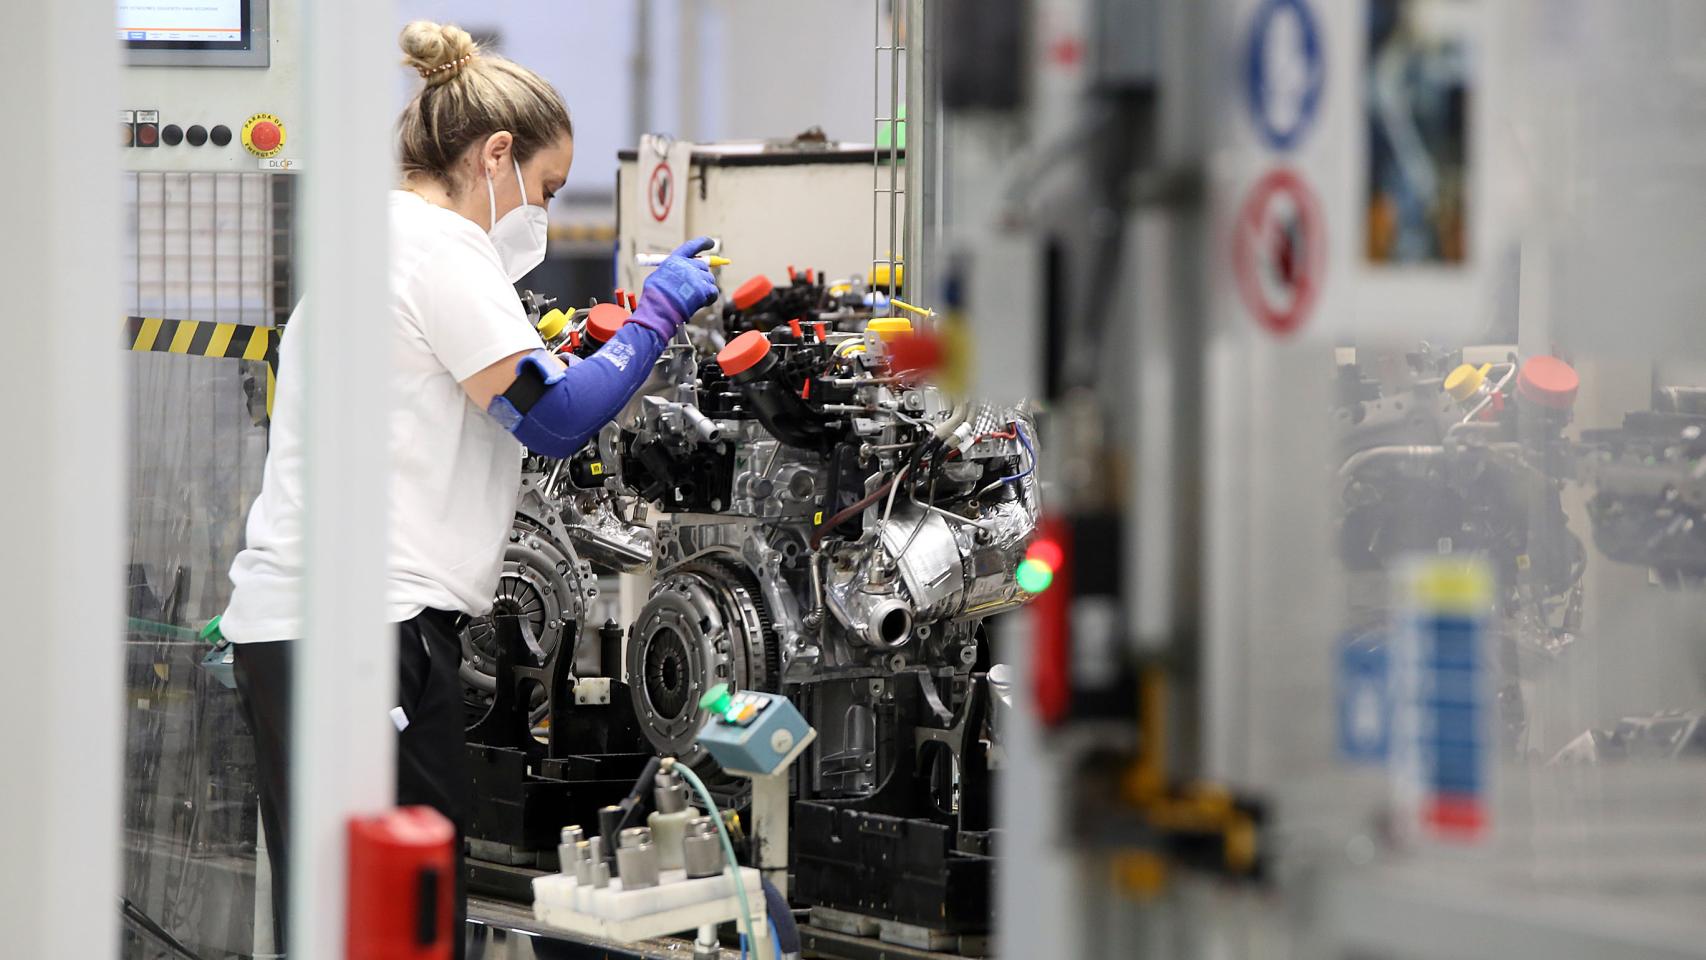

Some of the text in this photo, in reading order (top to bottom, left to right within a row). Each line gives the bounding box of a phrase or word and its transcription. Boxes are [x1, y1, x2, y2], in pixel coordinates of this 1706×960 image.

[244, 113, 283, 128] PARADA DE
[244, 143, 284, 158] EMERGENCIA
